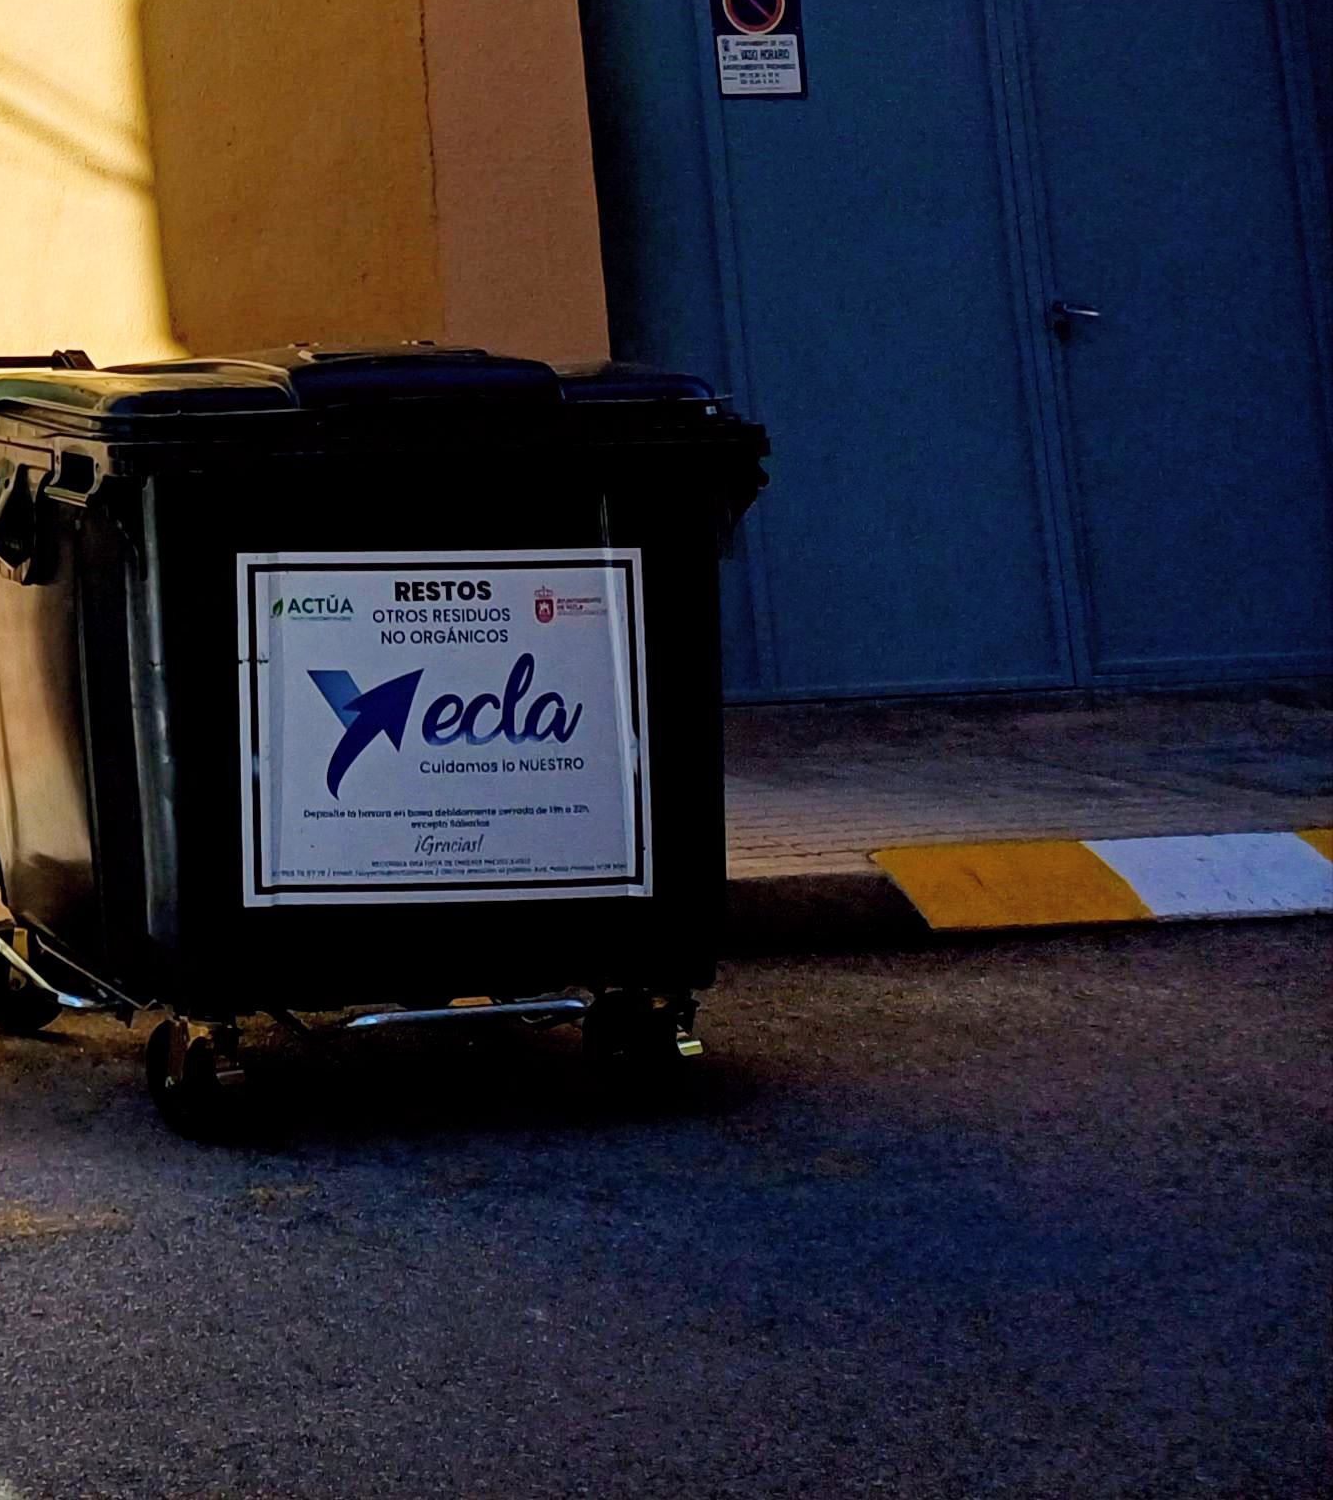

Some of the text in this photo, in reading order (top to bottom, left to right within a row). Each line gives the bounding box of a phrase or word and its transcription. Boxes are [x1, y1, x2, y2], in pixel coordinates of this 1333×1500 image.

[394, 580, 492, 602] RESTOS
[287, 594, 354, 614] ACTÚA
[372, 608, 511, 623] OTROS RESIDUOS
[381, 626, 509, 645] NO ORGÁNICOS
[420, 757, 584, 774] Cuidamos lo NUESTRO
[435, 806, 497, 816] debidamente
[536, 805, 547, 814] de
[411, 820, 448, 829] excepto
[414, 834, 484, 856] ¡Gracias!
